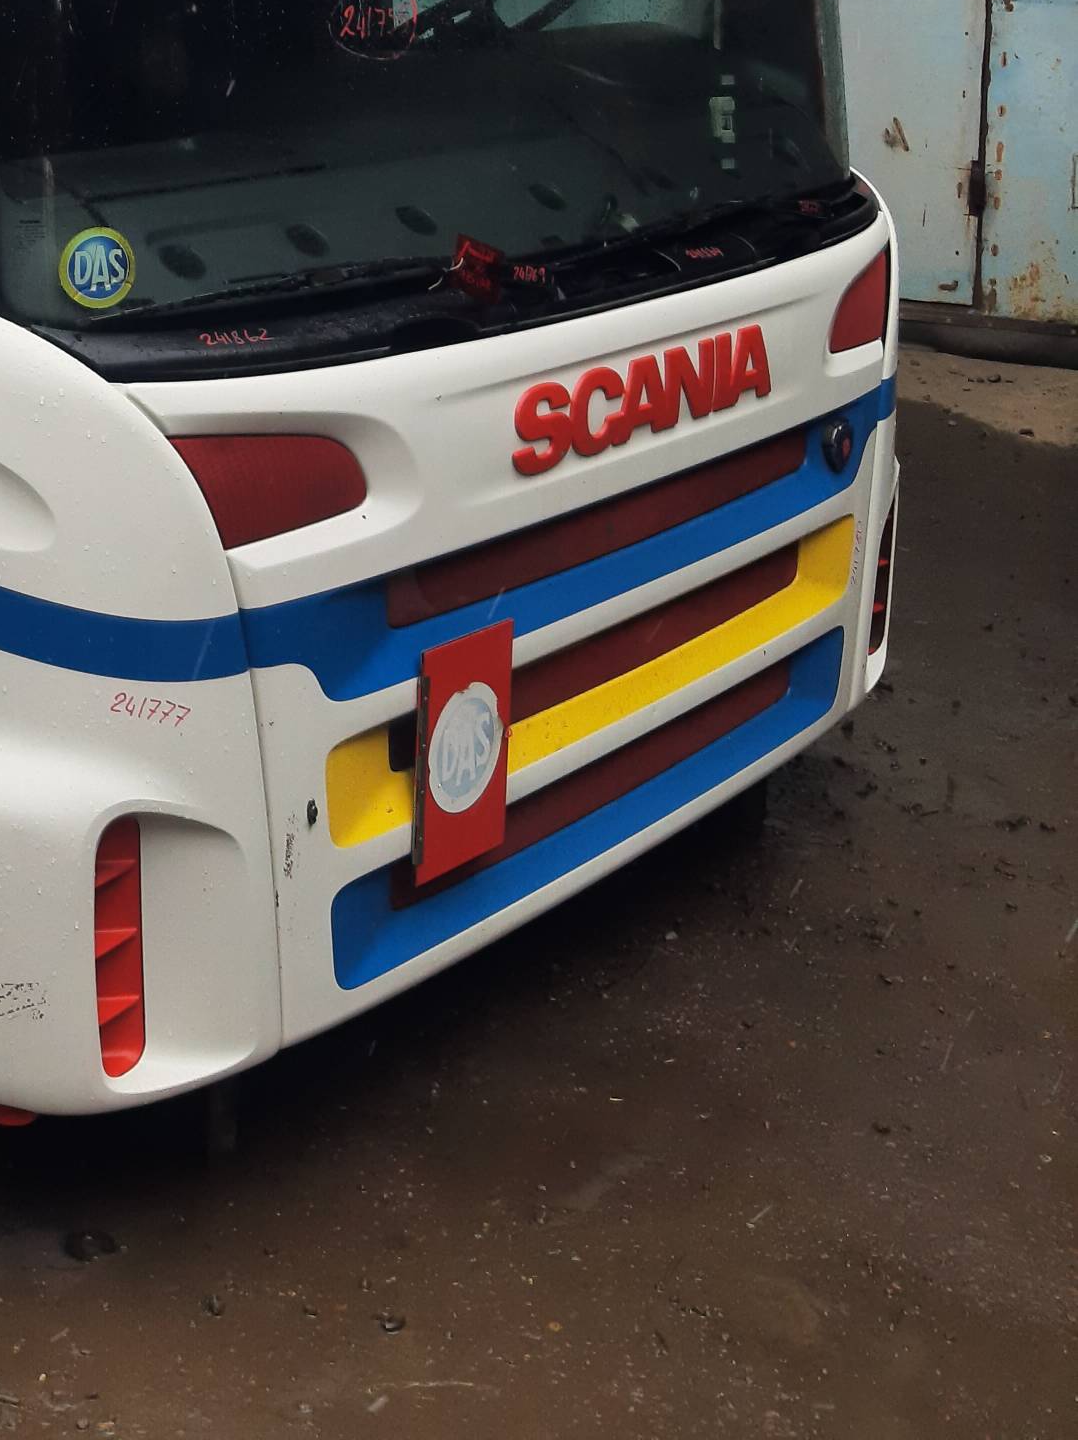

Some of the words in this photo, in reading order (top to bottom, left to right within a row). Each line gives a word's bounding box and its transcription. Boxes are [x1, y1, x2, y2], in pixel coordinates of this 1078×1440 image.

[74, 244, 125, 291] DAS
[199, 329, 273, 345] 241862
[511, 324, 772, 476] SCANIA
[110, 692, 191, 727] 241777
[442, 704, 491, 786] DAS
